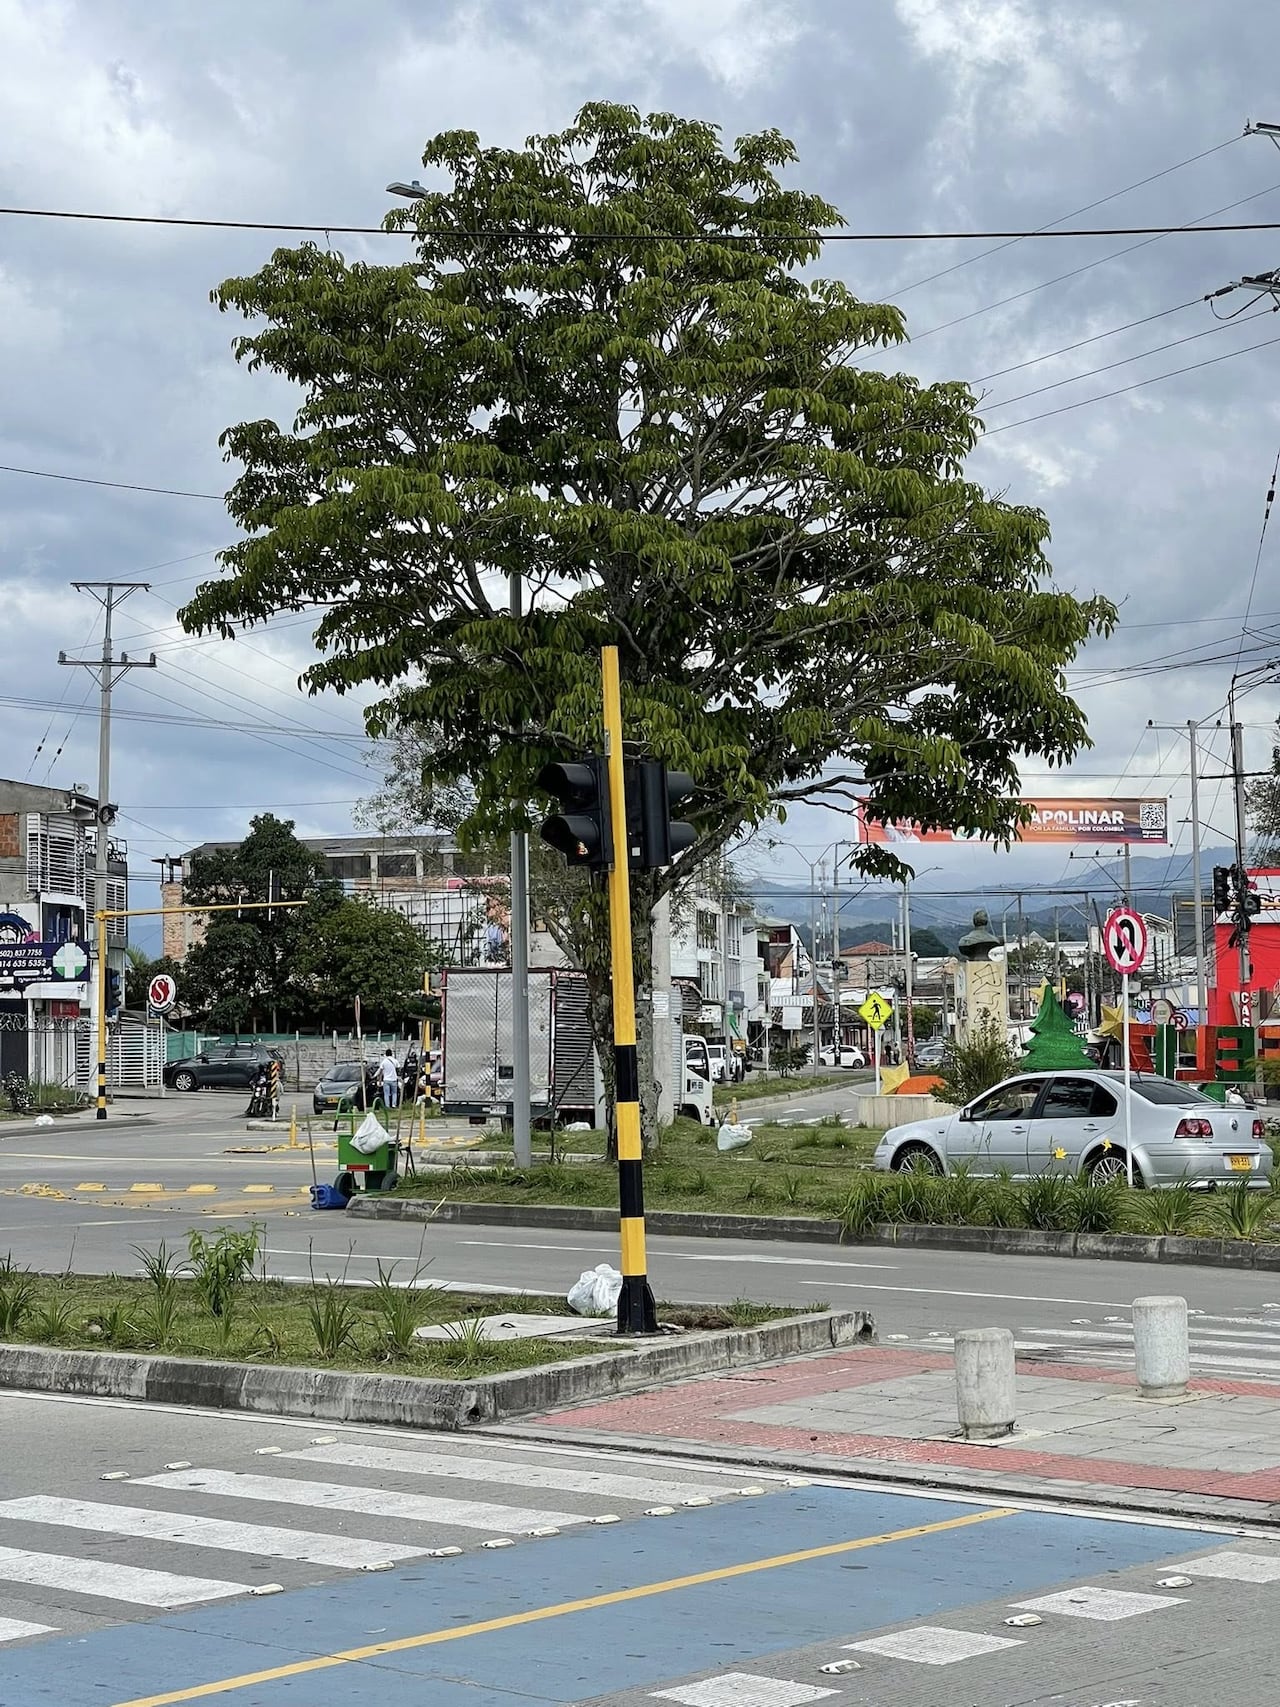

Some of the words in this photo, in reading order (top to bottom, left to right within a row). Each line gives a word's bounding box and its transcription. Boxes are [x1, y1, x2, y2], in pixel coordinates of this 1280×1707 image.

[1031, 810, 1124, 825] APOLINAR
[14, 949, 26, 957] 837
[27, 948, 43, 956] 7755
[12, 960, 27, 968] 635
